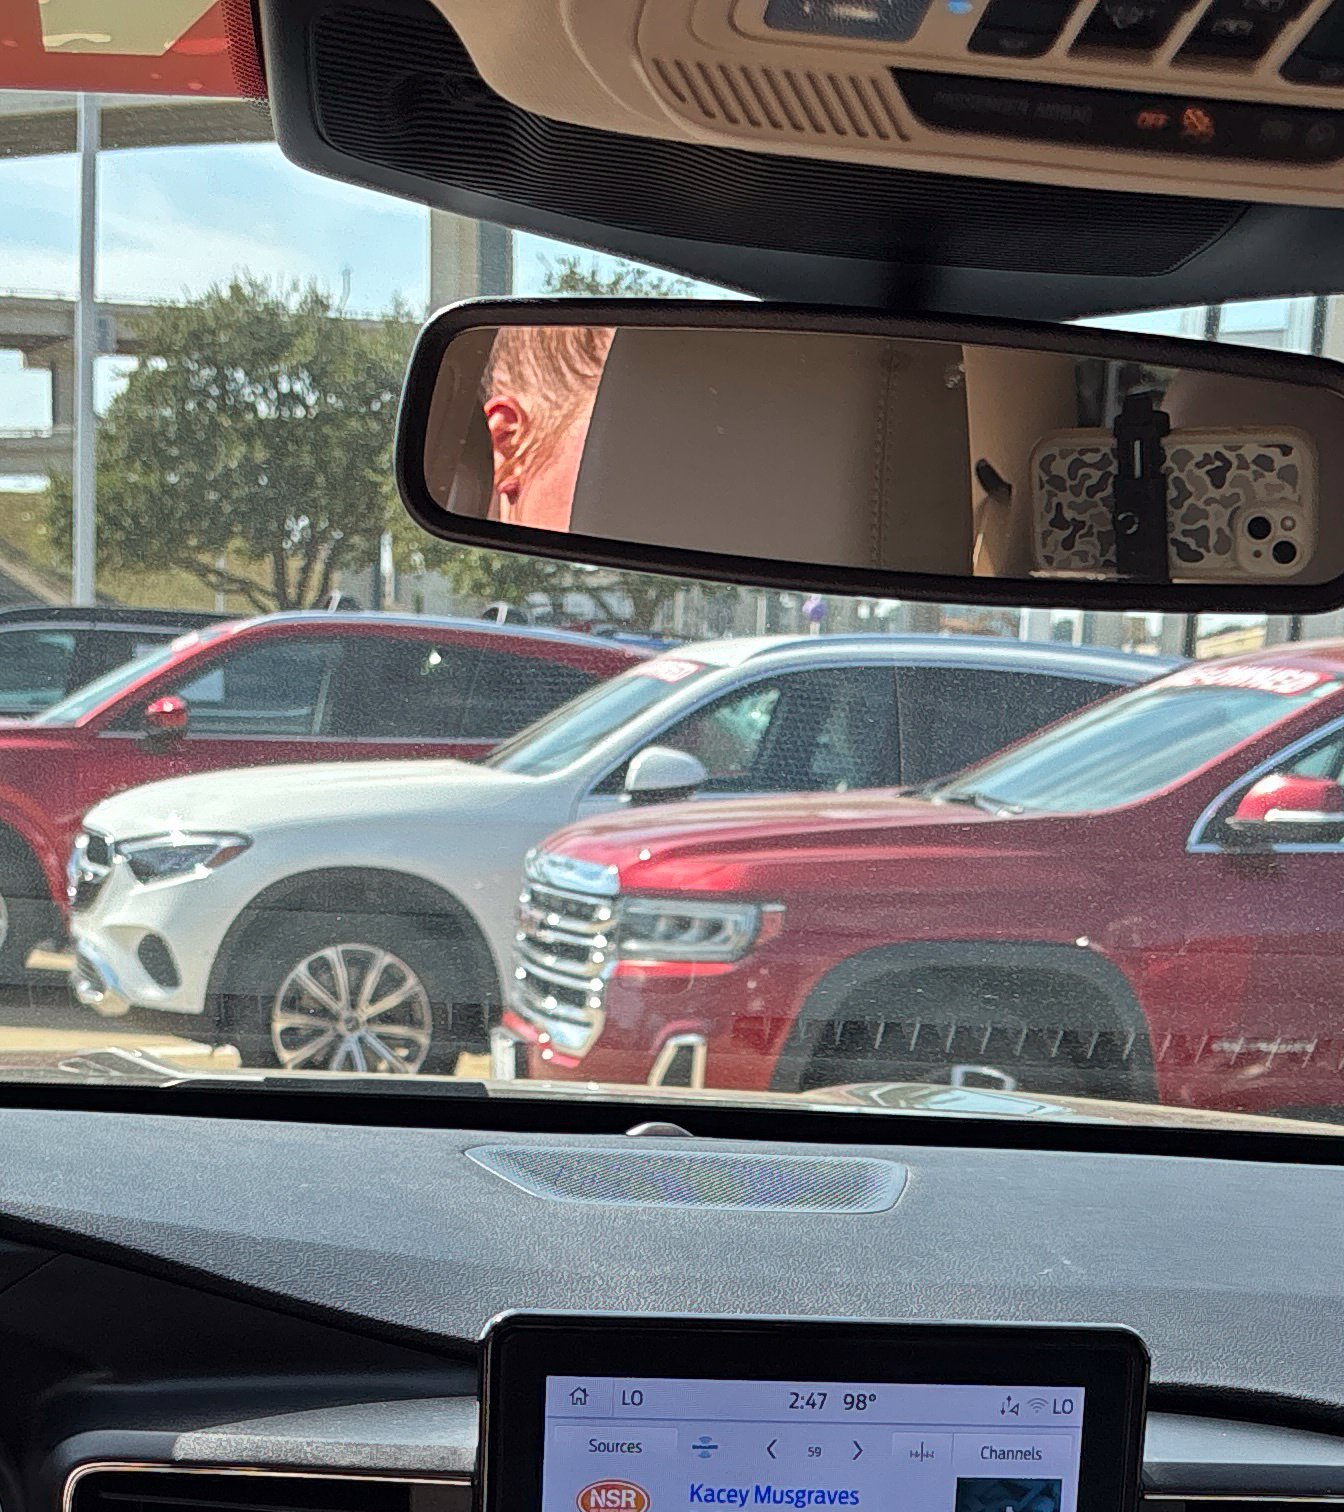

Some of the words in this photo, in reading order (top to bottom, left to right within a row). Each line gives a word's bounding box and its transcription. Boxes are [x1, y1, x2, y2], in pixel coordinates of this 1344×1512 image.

[621, 1389, 644, 1406] LO
[788, 1391, 828, 1410] 2:47
[843, 1393, 877, 1411] 98°
[1052, 1398, 1074, 1415] LO
[589, 1438, 643, 1454] Sources
[807, 1446, 822, 1458] 59
[980, 1446, 1042, 1461] Channels
[590, 1488, 636, 1508] NSR
[689, 1483, 750, 1508] Kacey
[754, 1485, 860, 1509] Musgraves
